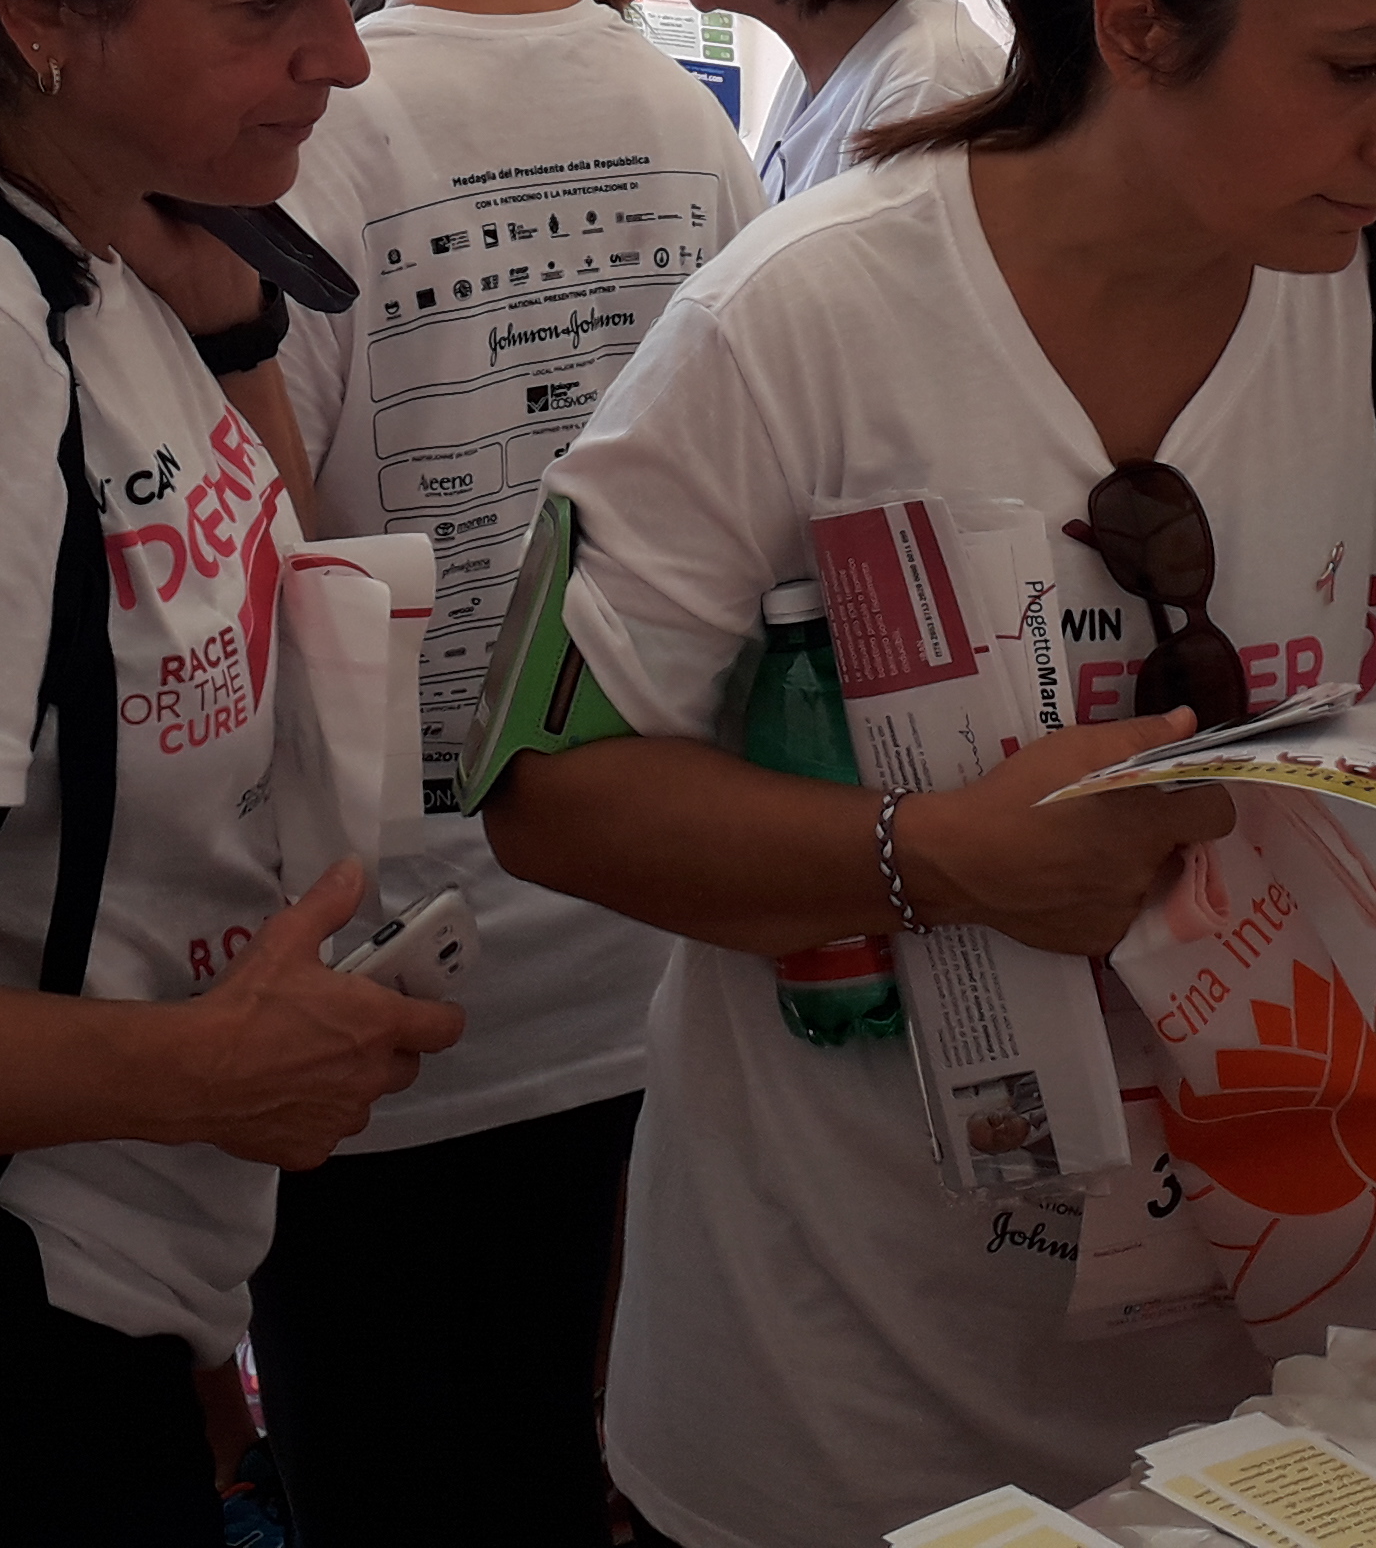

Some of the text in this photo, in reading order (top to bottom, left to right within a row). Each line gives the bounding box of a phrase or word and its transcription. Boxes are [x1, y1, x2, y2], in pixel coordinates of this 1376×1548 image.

[451, 154, 651, 188] Medaglia del Presidente della Repubblica
[159, 624, 239, 688] RACE
[195, 658, 245, 713] THE
[158, 693, 249, 756] CURE
